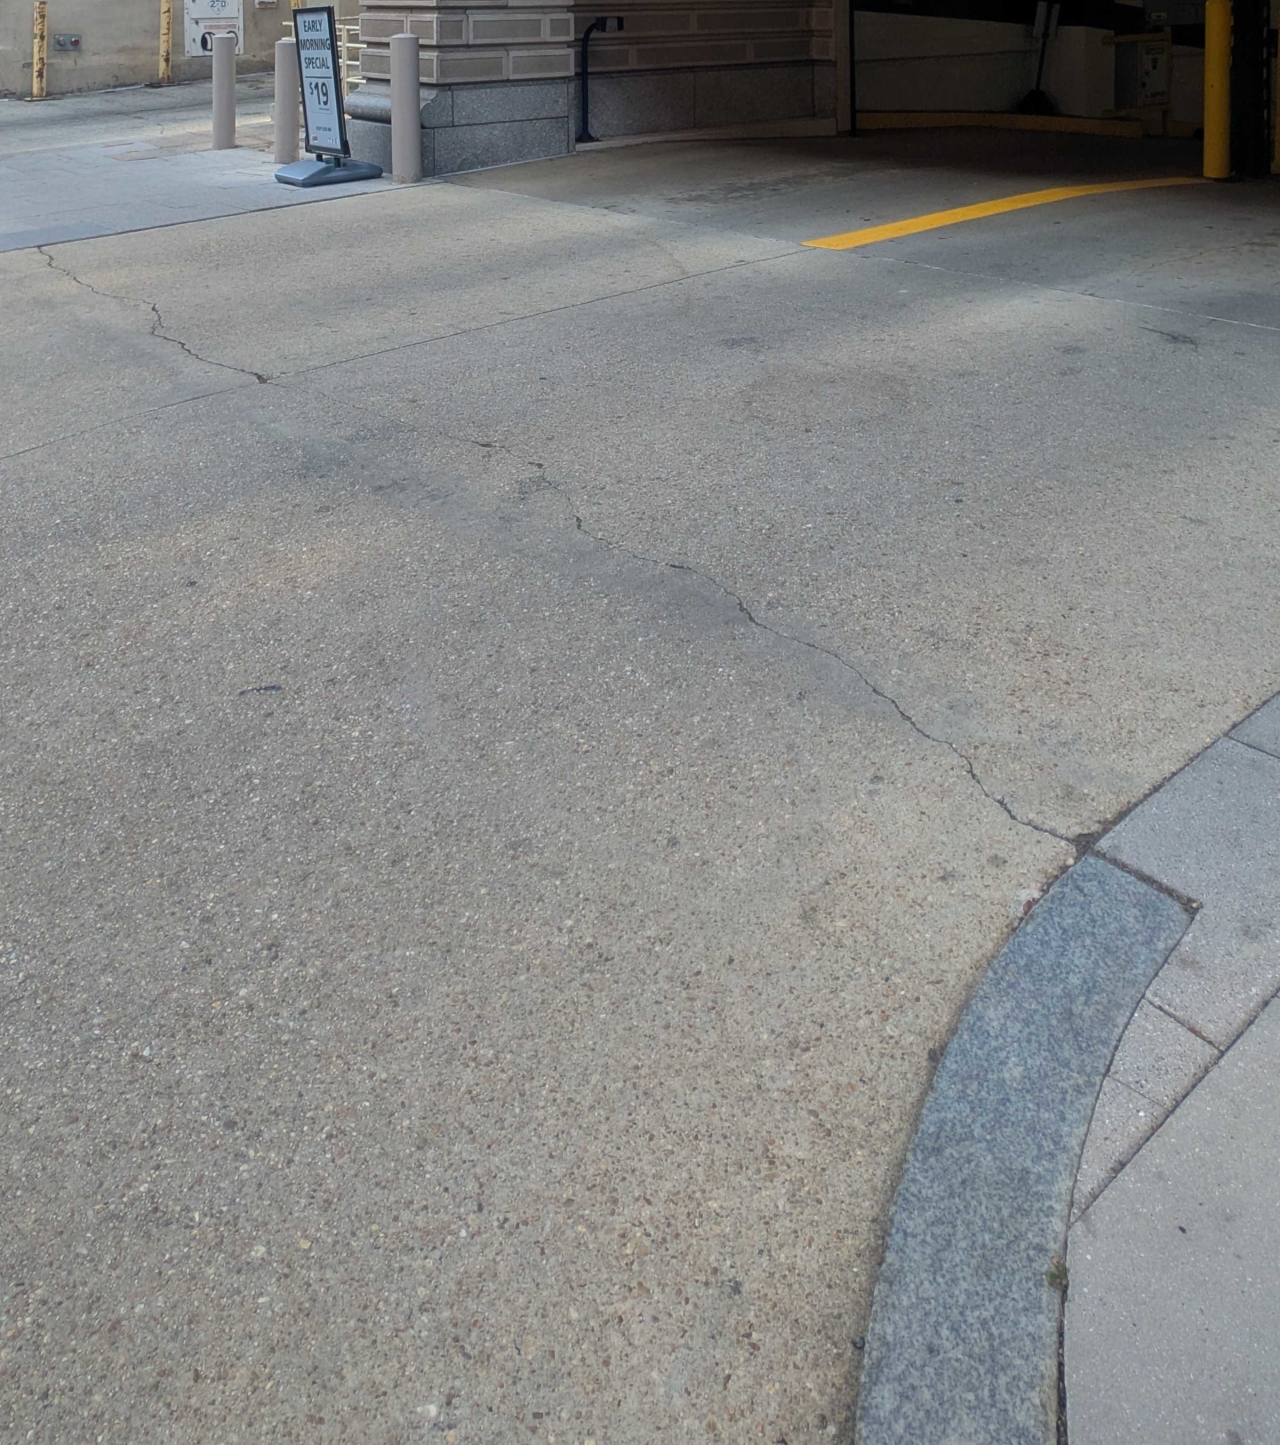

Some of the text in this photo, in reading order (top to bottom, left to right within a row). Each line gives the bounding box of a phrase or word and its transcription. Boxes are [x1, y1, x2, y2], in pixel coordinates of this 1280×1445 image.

[303, 19, 323, 33] EARLY
[300, 38, 331, 51] MORNING
[304, 56, 330, 70] SPECIAL
[309, 81, 329, 107] $19
